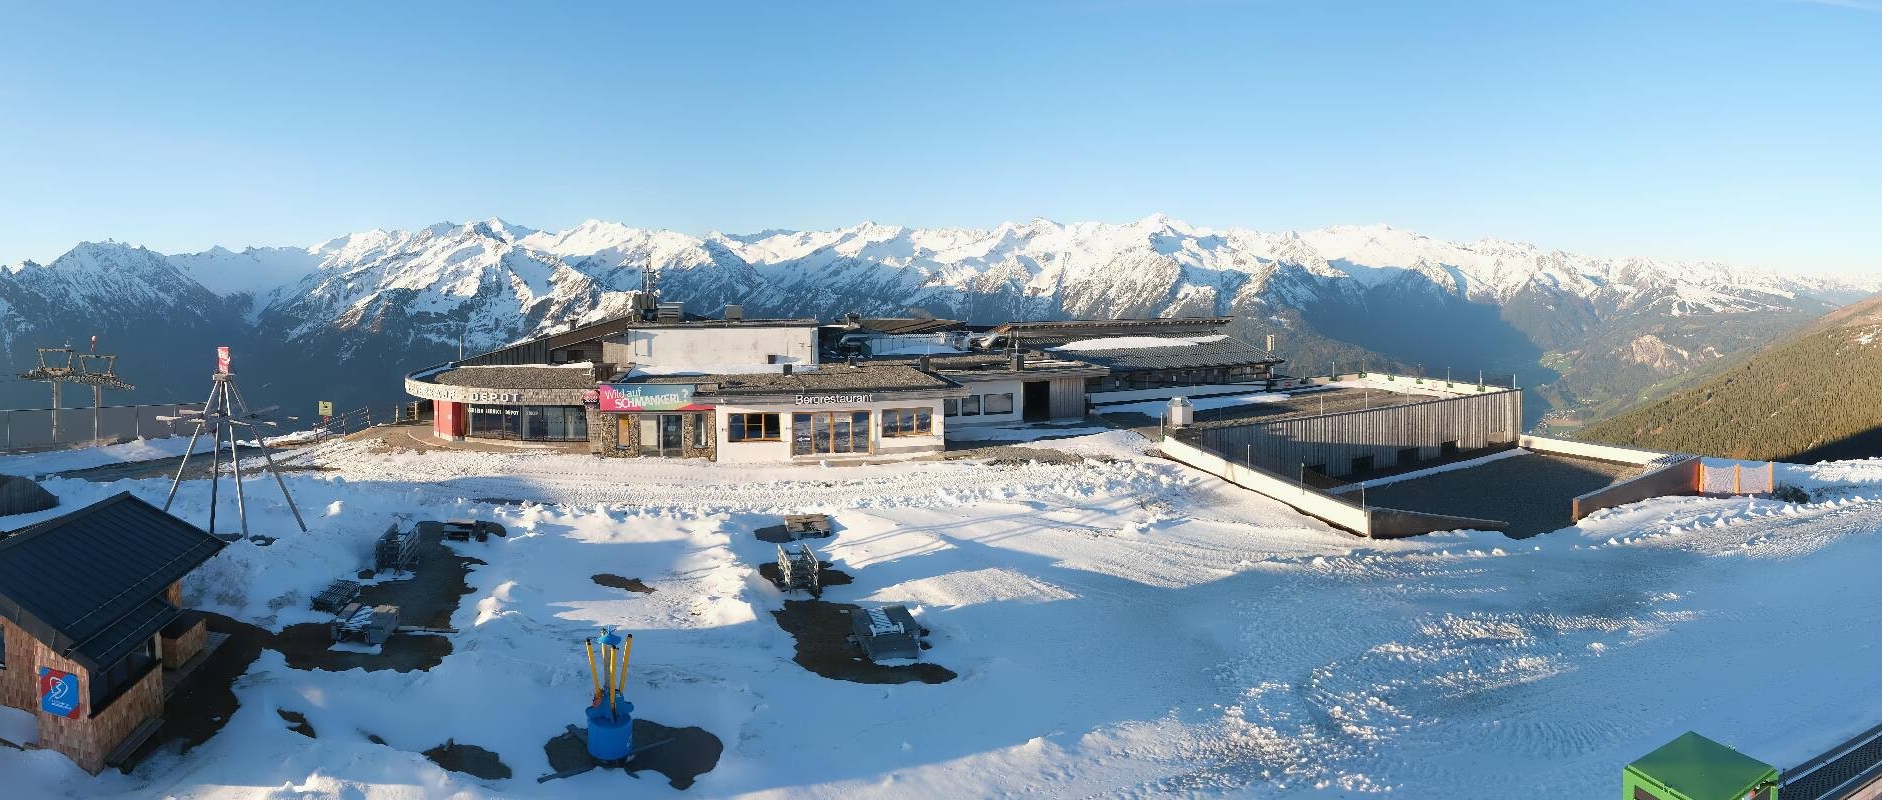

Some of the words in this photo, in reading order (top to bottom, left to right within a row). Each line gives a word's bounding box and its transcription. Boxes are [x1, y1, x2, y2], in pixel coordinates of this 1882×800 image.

[471, 393, 519, 402] DEPOT
[604, 388, 624, 399] Wild
[626, 386, 642, 398] auf
[795, 393, 873, 406] Bergrestaurant
